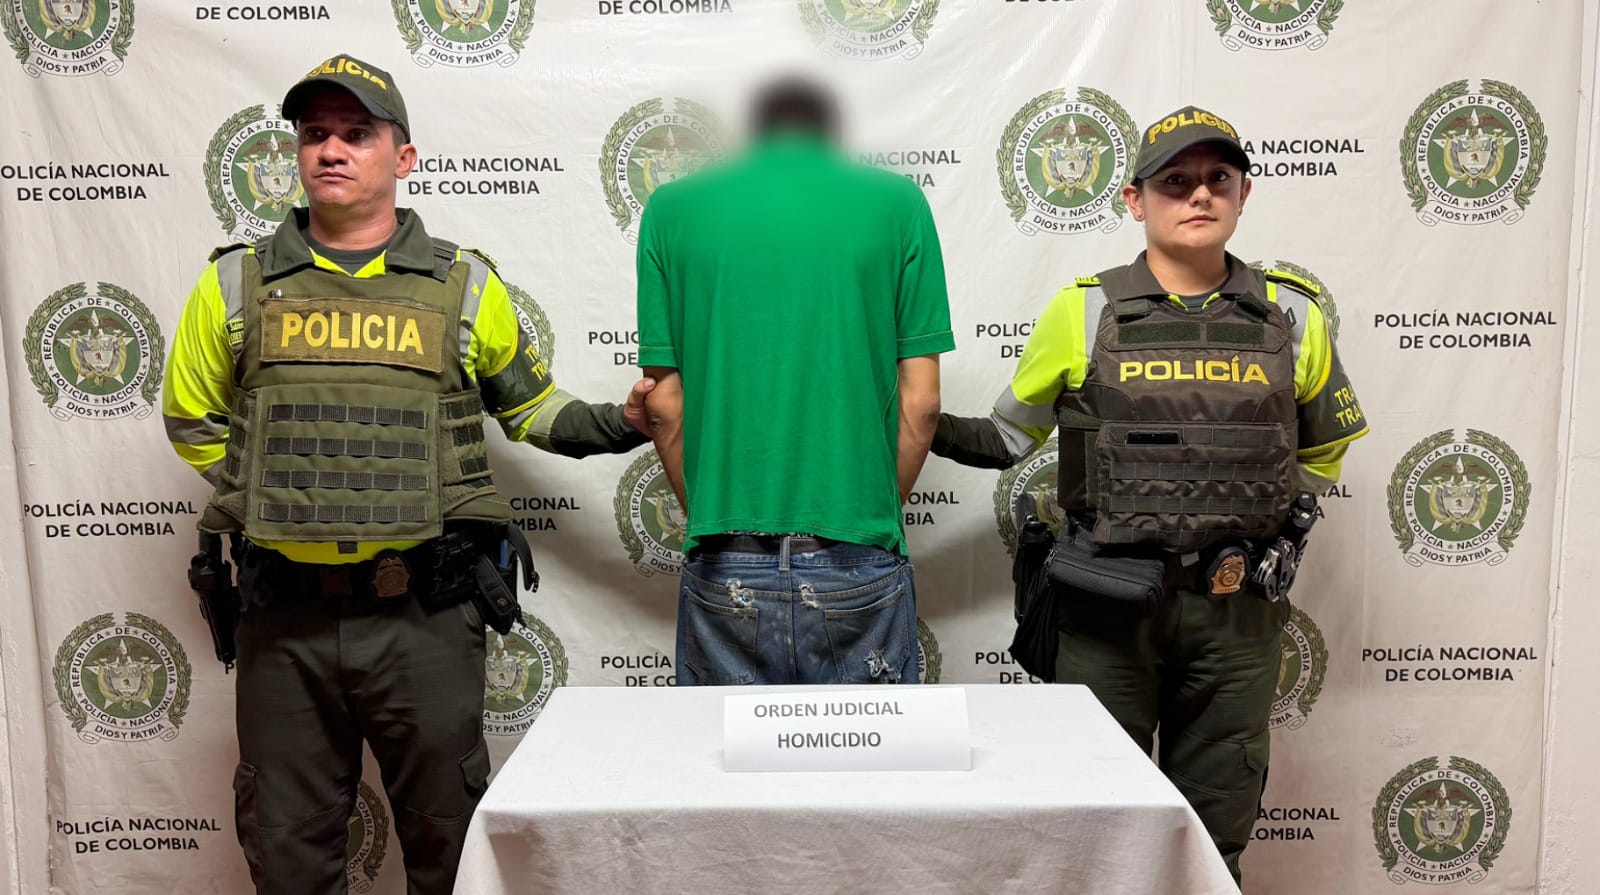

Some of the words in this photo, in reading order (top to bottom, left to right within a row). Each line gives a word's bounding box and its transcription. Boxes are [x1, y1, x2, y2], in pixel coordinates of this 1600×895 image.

[196, 7, 221, 20] DE
[227, 6, 330, 20] COLOMBIA
[599, 1, 623, 15] DE
[629, 0, 732, 14] COLOMBIA
[820, 11, 856, 41] POLICIA
[870, 5, 919, 42] NACIONAL
[22, 27, 58, 58] POLICIA
[72, 24, 116, 59] NACIONAL
[417, 20, 453, 49] POLICIA
[466, 18, 515, 51] NACIONAL
[1238, 30, 1263, 45] DIOS
[1275, 30, 1312, 47] PATRIA
[870, 39, 907, 56] PATRIA
[36, 57, 60, 71] DIOS
[72, 56, 107, 73] PATRIA
[429, 49, 454, 63] DIOS
[466, 49, 503, 64] PATRIA
[1418, 102, 1457, 161] REPUBLICA
[1468, 96, 1484, 104] DE
[1497, 101, 1528, 159] COLOMBIA
[1016, 111, 1053, 171] REPUBLICA
[1065, 104, 1081, 112] DE
[1092, 110, 1125, 168] COLOMBIA
[618, 121, 652, 181] REPUBLICA
[664, 115, 678, 123] DE
[1262, 139, 1364, 154] NACIONAL
[222, 127, 255, 185] REPUBLICA
[411, 155, 457, 172] ICÍA
[463, 157, 564, 172] NACIONAL
[0, 162, 67, 179] OLICÍA
[71, 163, 169, 178] NACIONAL
[1248, 162, 1337, 176] OLOMBIA
[17, 187, 43, 201] DE
[49, 186, 147, 201] COLOMBIA
[408, 181, 432, 194] DE
[438, 180, 540, 194] COLOMBIA
[1423, 175, 1459, 206] POLICIA
[1472, 171, 1522, 207] NACIONAL
[1022, 185, 1057, 216] POLICIA
[1069, 182, 1119, 217] NACIONAL
[230, 198, 266, 229] POLICIA
[1434, 206, 1460, 220] DIOS
[1472, 205, 1508, 221] PATRIA
[1033, 215, 1058, 230] DIOS
[1069, 214, 1106, 231] PATRIA
[1374, 309, 1450, 328] POLICÍA
[1456, 311, 1556, 326] NACIONAL
[43, 303, 77, 360] REPUBLICA
[113, 304, 149, 358] COLOMBIA
[280, 311, 424, 355] POLICIA
[976, 318, 1036, 337] POLIC
[589, 331, 639, 344] POLIC
[1400, 335, 1424, 349] DE
[1430, 333, 1531, 348] COLOMBIA
[614, 352, 636, 365] DE
[1001, 345, 1024, 358] DE
[1120, 355, 1270, 385] POLICÍA
[52, 373, 89, 402] POLICIA
[102, 371, 147, 404] NACIONAL
[66, 402, 92, 415] DIOS
[103, 401, 138, 417] PATRIA
[1406, 451, 1442, 506] REPUBLICA
[1480, 451, 1512, 505] COLOMBIA
[632, 464, 664, 518] REPUBLICA
[908, 491, 959, 505] ONAL
[24, 500, 95, 517] POLICÍA
[101, 501, 198, 515] NACIONAL
[510, 497, 580, 510] CIONAL
[46, 525, 71, 537] DE
[76, 522, 175, 536] COLOMBIA
[512, 517, 556, 531] MBIA
[1410, 519, 1443, 548] POLICIA
[1457, 517, 1506, 550] NACIONAL
[638, 530, 672, 559] POLICIA
[1420, 548, 1445, 562] DIOS
[1456, 548, 1492, 563] PATRIA
[650, 558, 676, 572] DIOS
[519, 628, 551, 678] COLOMBIA
[1285, 623, 1310, 671] OLOMBIA
[1362, 645, 1434, 662] POLICÍA
[1439, 647, 1537, 660] NACIONAL
[72, 633, 104, 687] REPUBLICA
[142, 633, 176, 684] COLOMBIA
[601, 652, 672, 669] POLICÍA
[975, 652, 1015, 664] POLI
[626, 676, 648, 687] DE
[1000, 672, 1023, 684] DE
[1385, 669, 1409, 681] DE
[1414, 668, 1513, 681] COLOMBIA
[503, 690, 548, 720] NACIONAL
[1272, 684, 1305, 712] CIONAL
[80, 699, 117, 725] POLICIA
[130, 696, 173, 727] NACIONAL
[754, 703, 817, 718] ORDEN
[823, 701, 903, 717] JUDICIAL
[95, 725, 119, 738] DIOS
[131, 724, 165, 739] PATRIA
[504, 719, 535, 733] PATRIA
[777, 732, 881, 749] HOMICIDIO
[1390, 776, 1426, 827] REPUBLICA
[1463, 777, 1493, 828] COLOMBIA
[358, 801, 373, 836] OMBIA
[1257, 808, 1340, 820] ACIONAL
[57, 817, 124, 835] POLICÍA
[129, 818, 221, 831] NACIONAL
[1249, 827, 1314, 840] OMBIA
[76, 841, 100, 853] DE
[105, 838, 199, 850] COLOMBIA
[347, 848, 369, 872] IONAL
[1394, 840, 1427, 868] POLICIA
[1440, 840, 1486, 869] NACIONAL
[1404, 866, 1427, 881] DIOS
[1438, 867, 1472, 881] PATRIA
